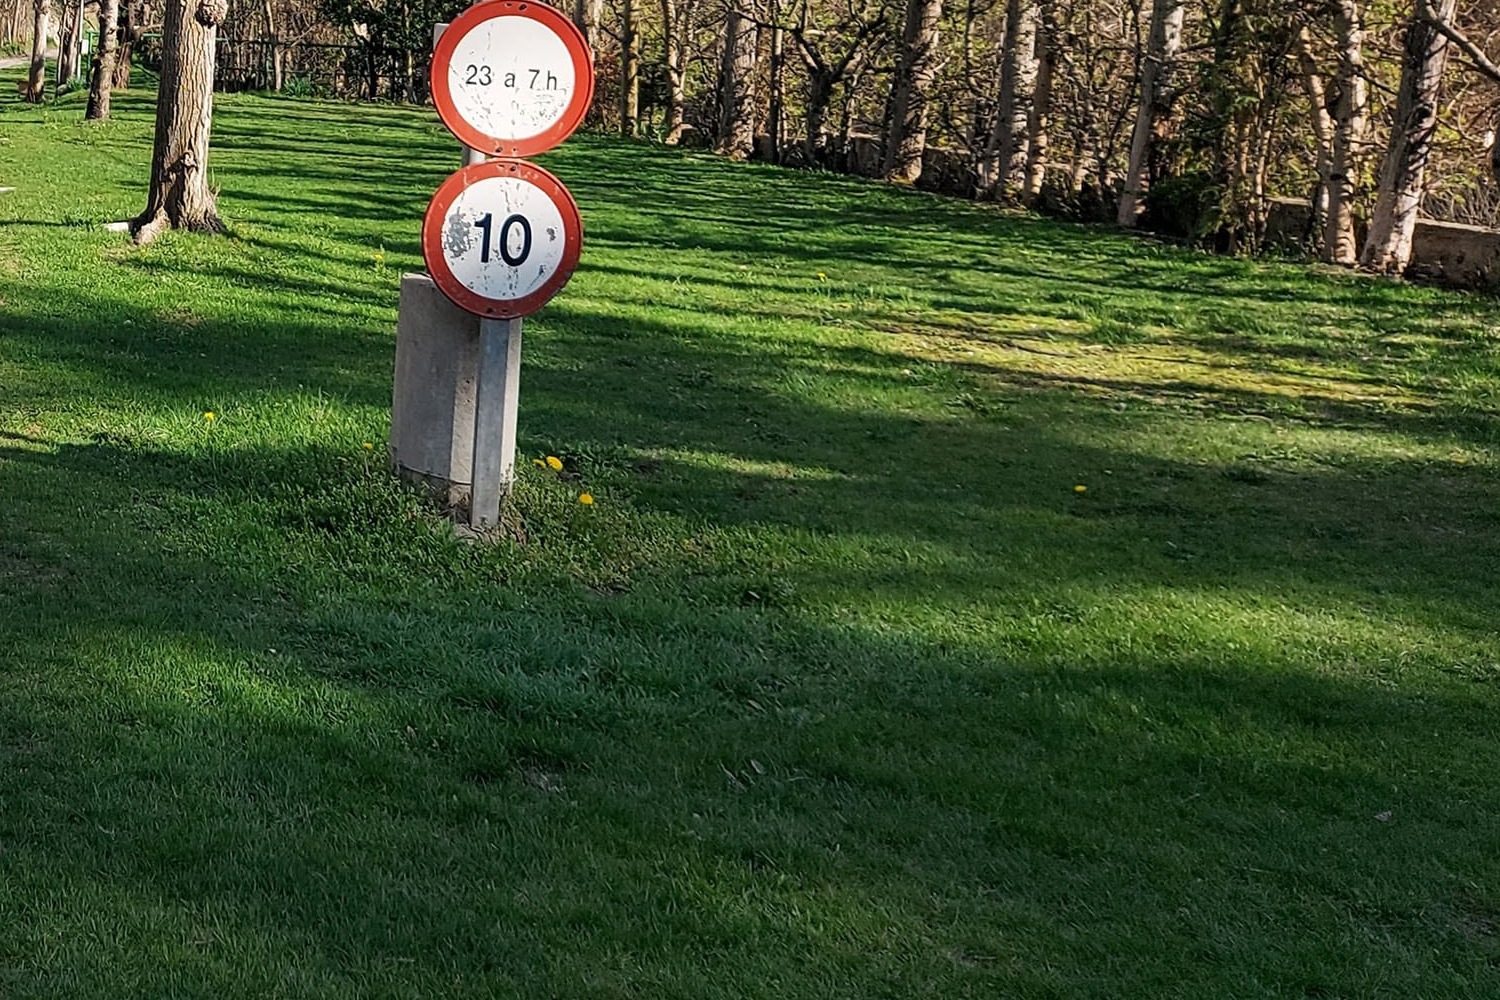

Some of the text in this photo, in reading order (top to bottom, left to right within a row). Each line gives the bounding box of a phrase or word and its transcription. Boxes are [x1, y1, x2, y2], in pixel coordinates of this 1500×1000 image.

[465, 64, 492, 86] 23
[504, 72, 516, 88] a
[474, 213, 532, 267] 10
